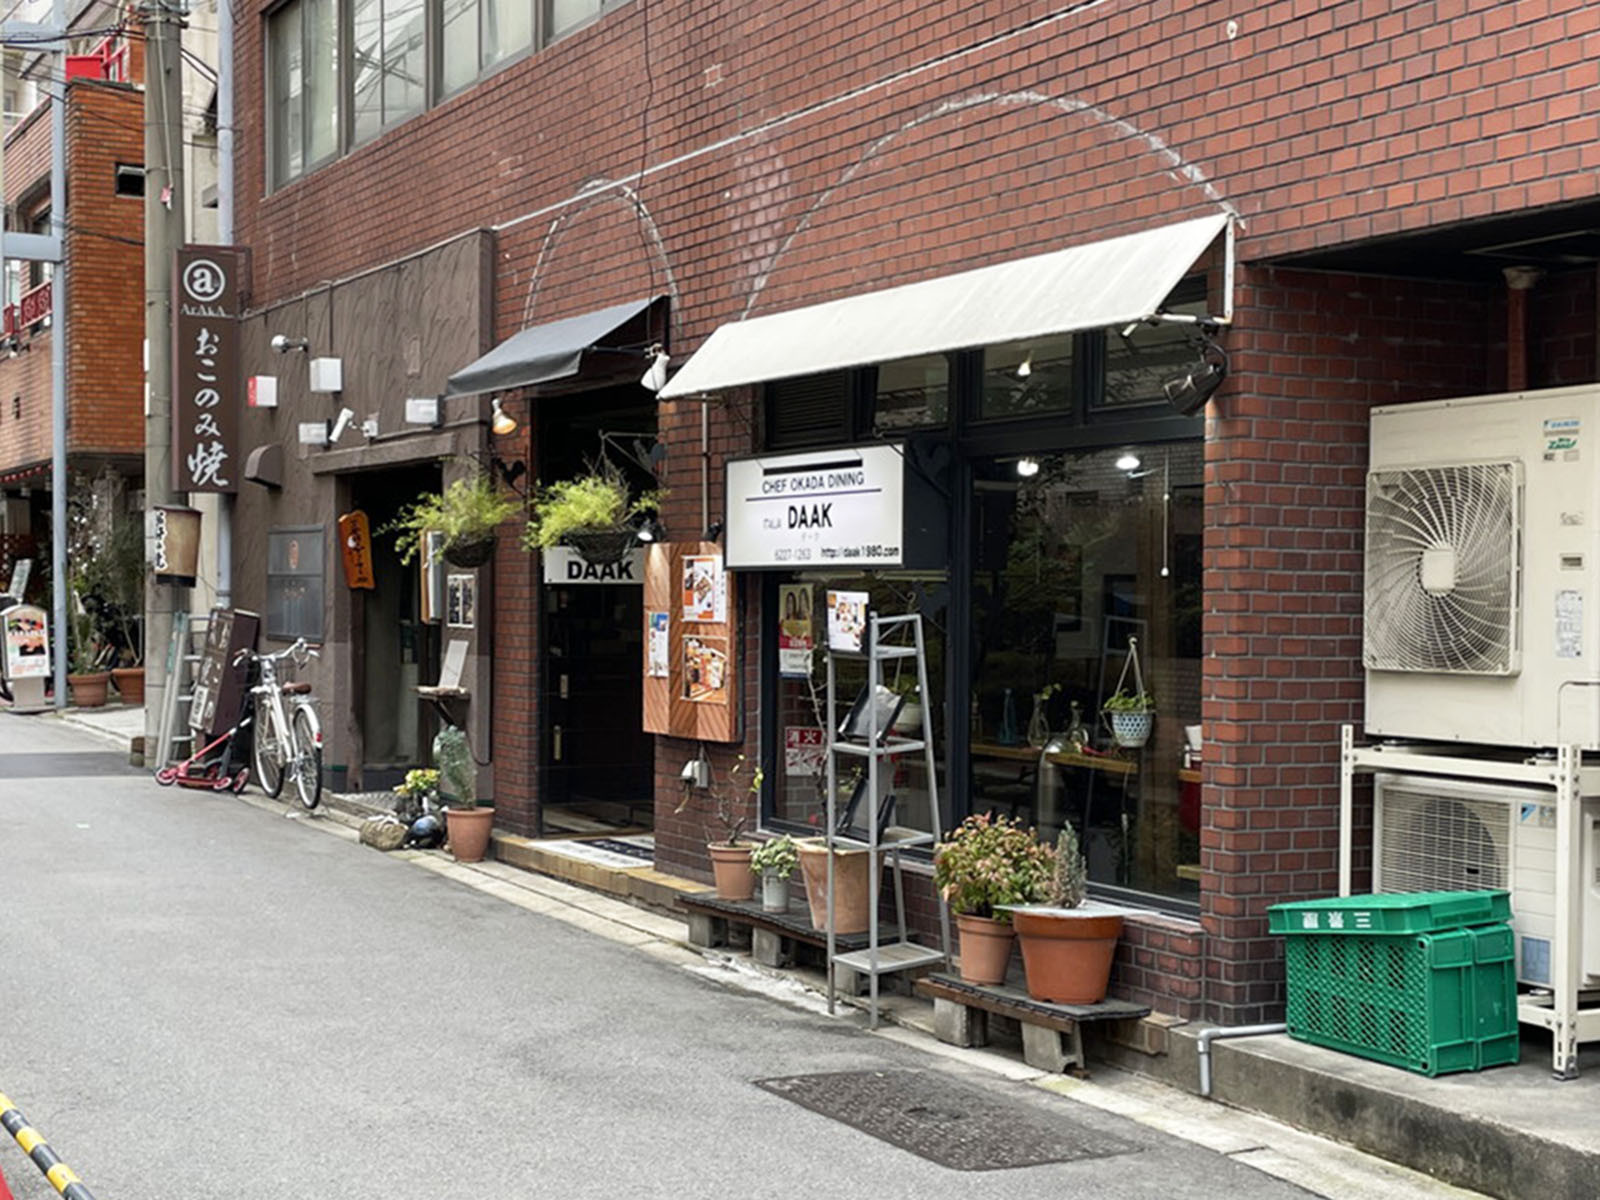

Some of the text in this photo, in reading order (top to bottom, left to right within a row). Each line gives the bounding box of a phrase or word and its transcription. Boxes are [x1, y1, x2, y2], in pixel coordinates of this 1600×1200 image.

[186, 327, 229, 486] おこのみ焼
[762, 471, 865, 494] CHEF OKADA DINING
[788, 503, 833, 529] DAAK
[567, 561, 634, 580] DAAK
